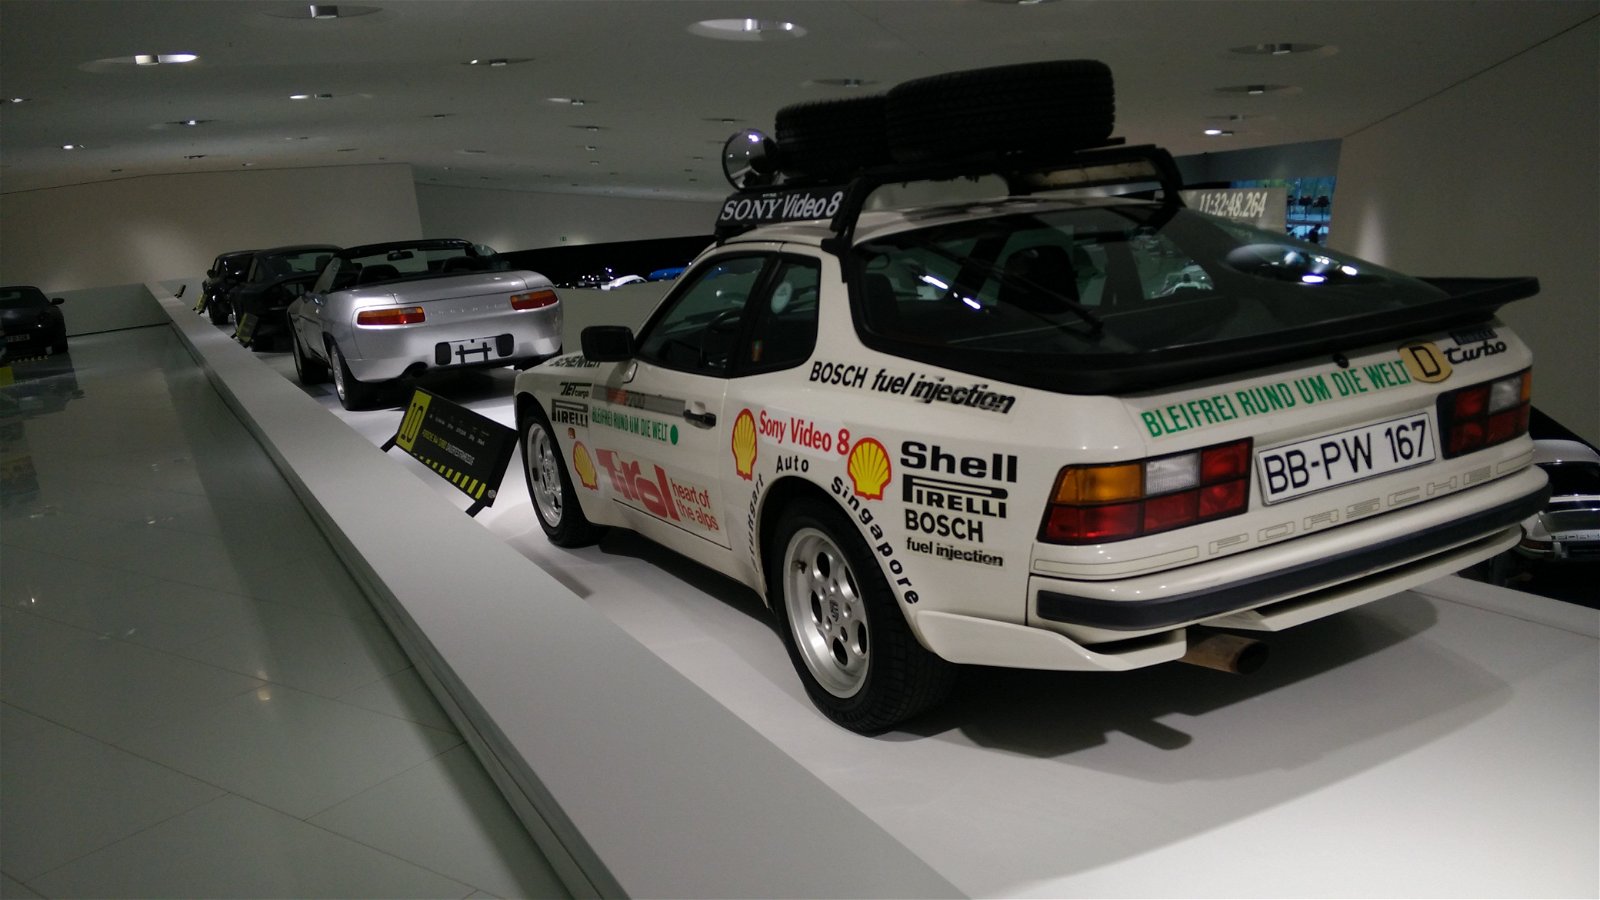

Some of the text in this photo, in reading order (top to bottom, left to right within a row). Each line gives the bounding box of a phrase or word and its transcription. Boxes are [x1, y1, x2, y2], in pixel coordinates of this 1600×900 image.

[720, 191, 843, 220] SONY Video 8
[1200, 192, 1268, 217] 11:32:48.264
[1409, 346, 1441, 377] D
[1443, 340, 1507, 364] turbo
[809, 361, 1016, 414] BOSCH fuel injection
[1141, 359, 1412, 437] BLEIFREI RUND UM DIE WELT
[552, 399, 588, 428] PIRELLI
[630, 415, 639, 435] UM
[641, 418, 651, 438] DIE
[652, 421, 668, 442] WELT
[759, 410, 850, 455] Sony Video 8
[776, 455, 809, 473] Auto
[900, 441, 1017, 483] Shell
[1264, 420, 1426, 494] BB-PW 167
[670, 478, 711, 509] heart of
[902, 474, 1008, 518] PIRELLI
[676, 500, 719, 531] the alps
[1208, 465, 1491, 555] PORSCHE
[831, 476, 919, 604] Singapore
[905, 509, 983, 543] BOSCH
[907, 537, 1003, 566] fuel injection
